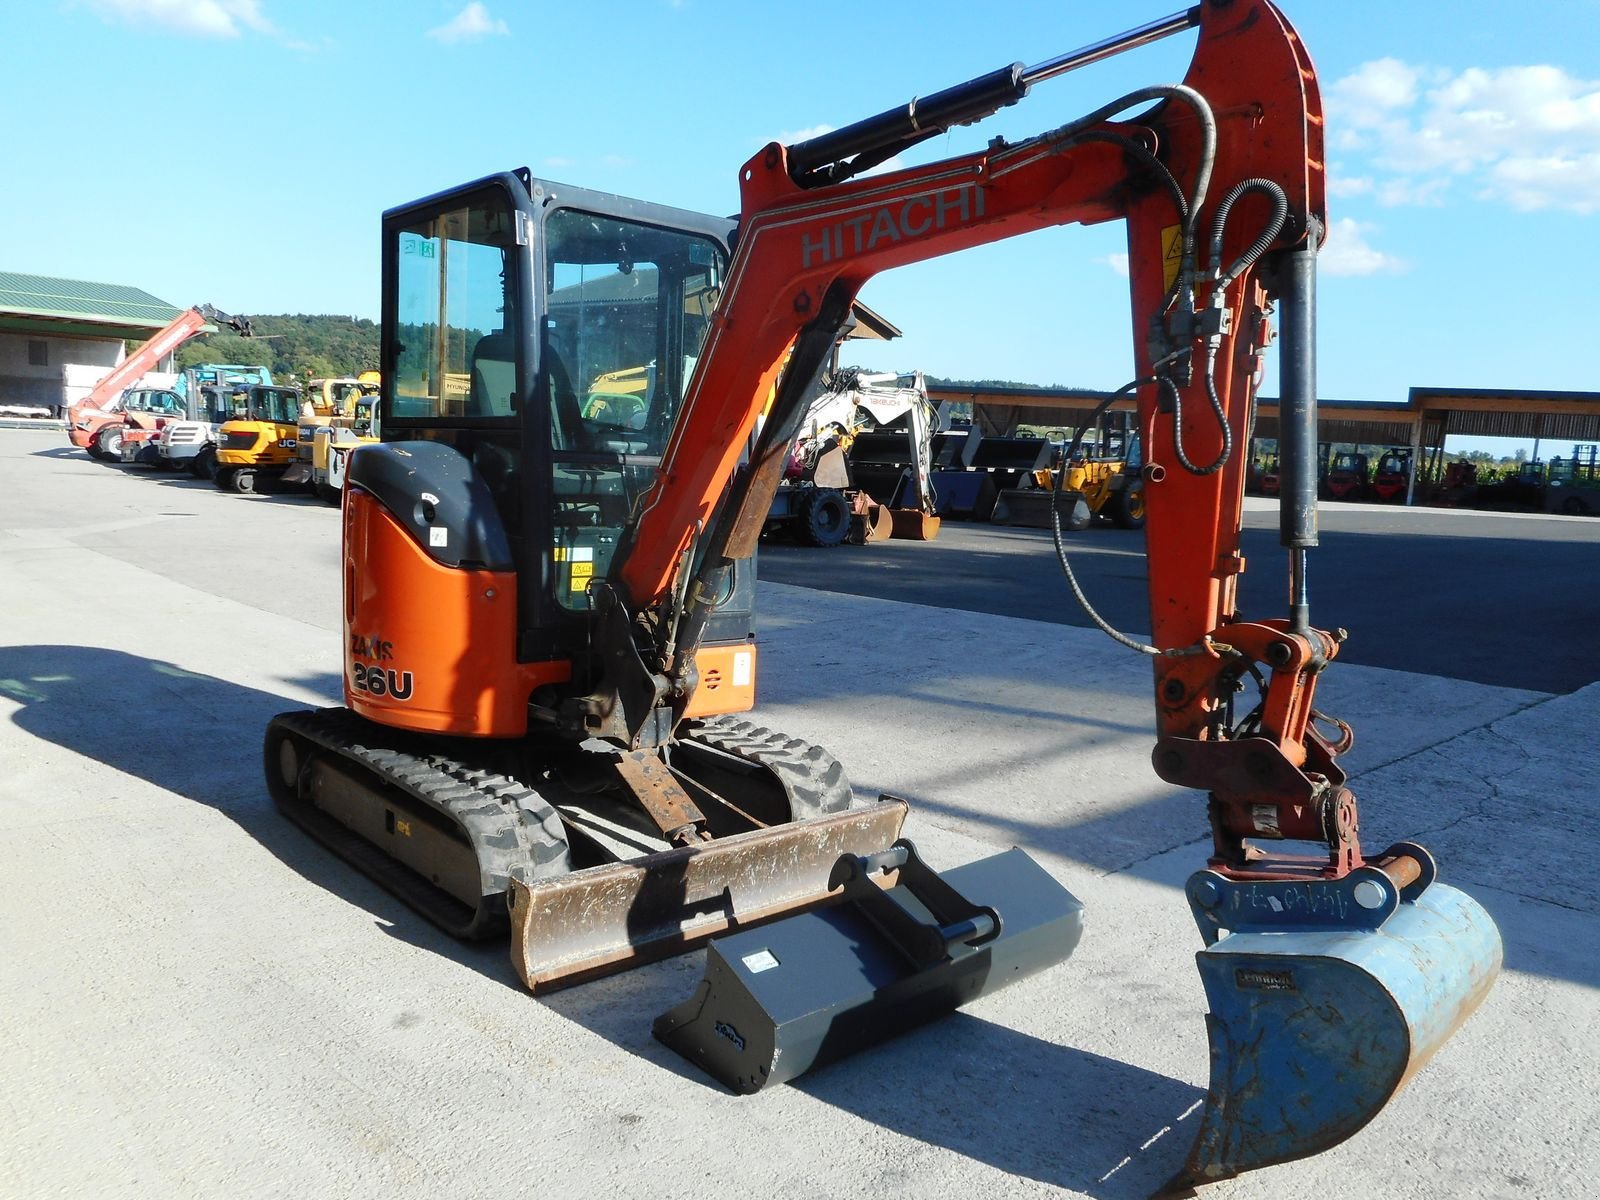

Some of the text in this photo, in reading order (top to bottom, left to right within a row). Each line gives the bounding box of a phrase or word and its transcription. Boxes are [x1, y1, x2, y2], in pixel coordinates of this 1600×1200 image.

[802, 185, 985, 269] HITACHI
[278, 439, 296, 448] JC
[351, 634, 394, 660] ZAXIS
[352, 661, 414, 701] 26U
